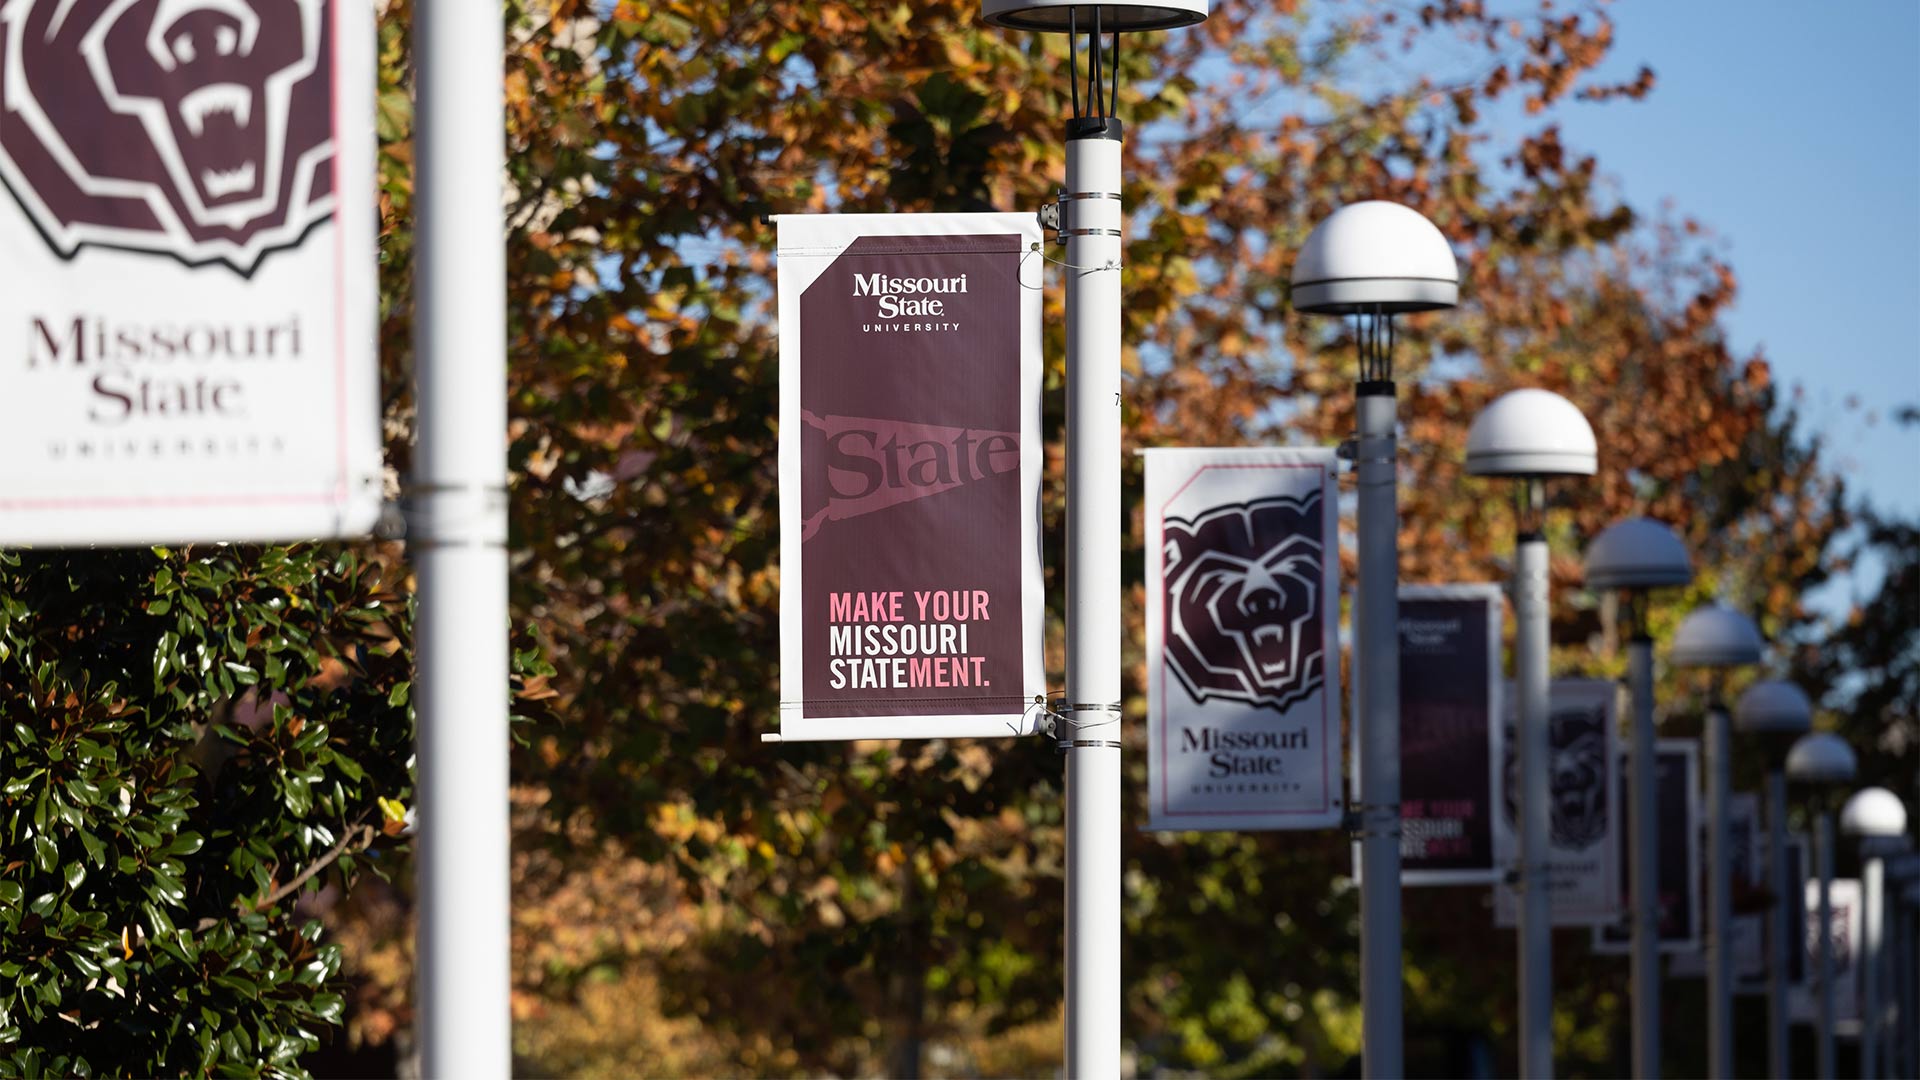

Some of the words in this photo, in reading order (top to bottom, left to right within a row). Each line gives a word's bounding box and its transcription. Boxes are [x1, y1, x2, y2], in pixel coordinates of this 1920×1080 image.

[852, 273, 968, 297] Missouri
[26, 312, 303, 368] Missouri
[862, 322, 960, 332] UNIVERSITY
[826, 426, 1019, 499] State
[829, 591, 905, 623] MAKE
[914, 590, 990, 621] YOUR
[829, 623, 968, 656] MISSOURI
[829, 656, 990, 689] STATEMENT.
[1181, 726, 1309, 752] Missouri
